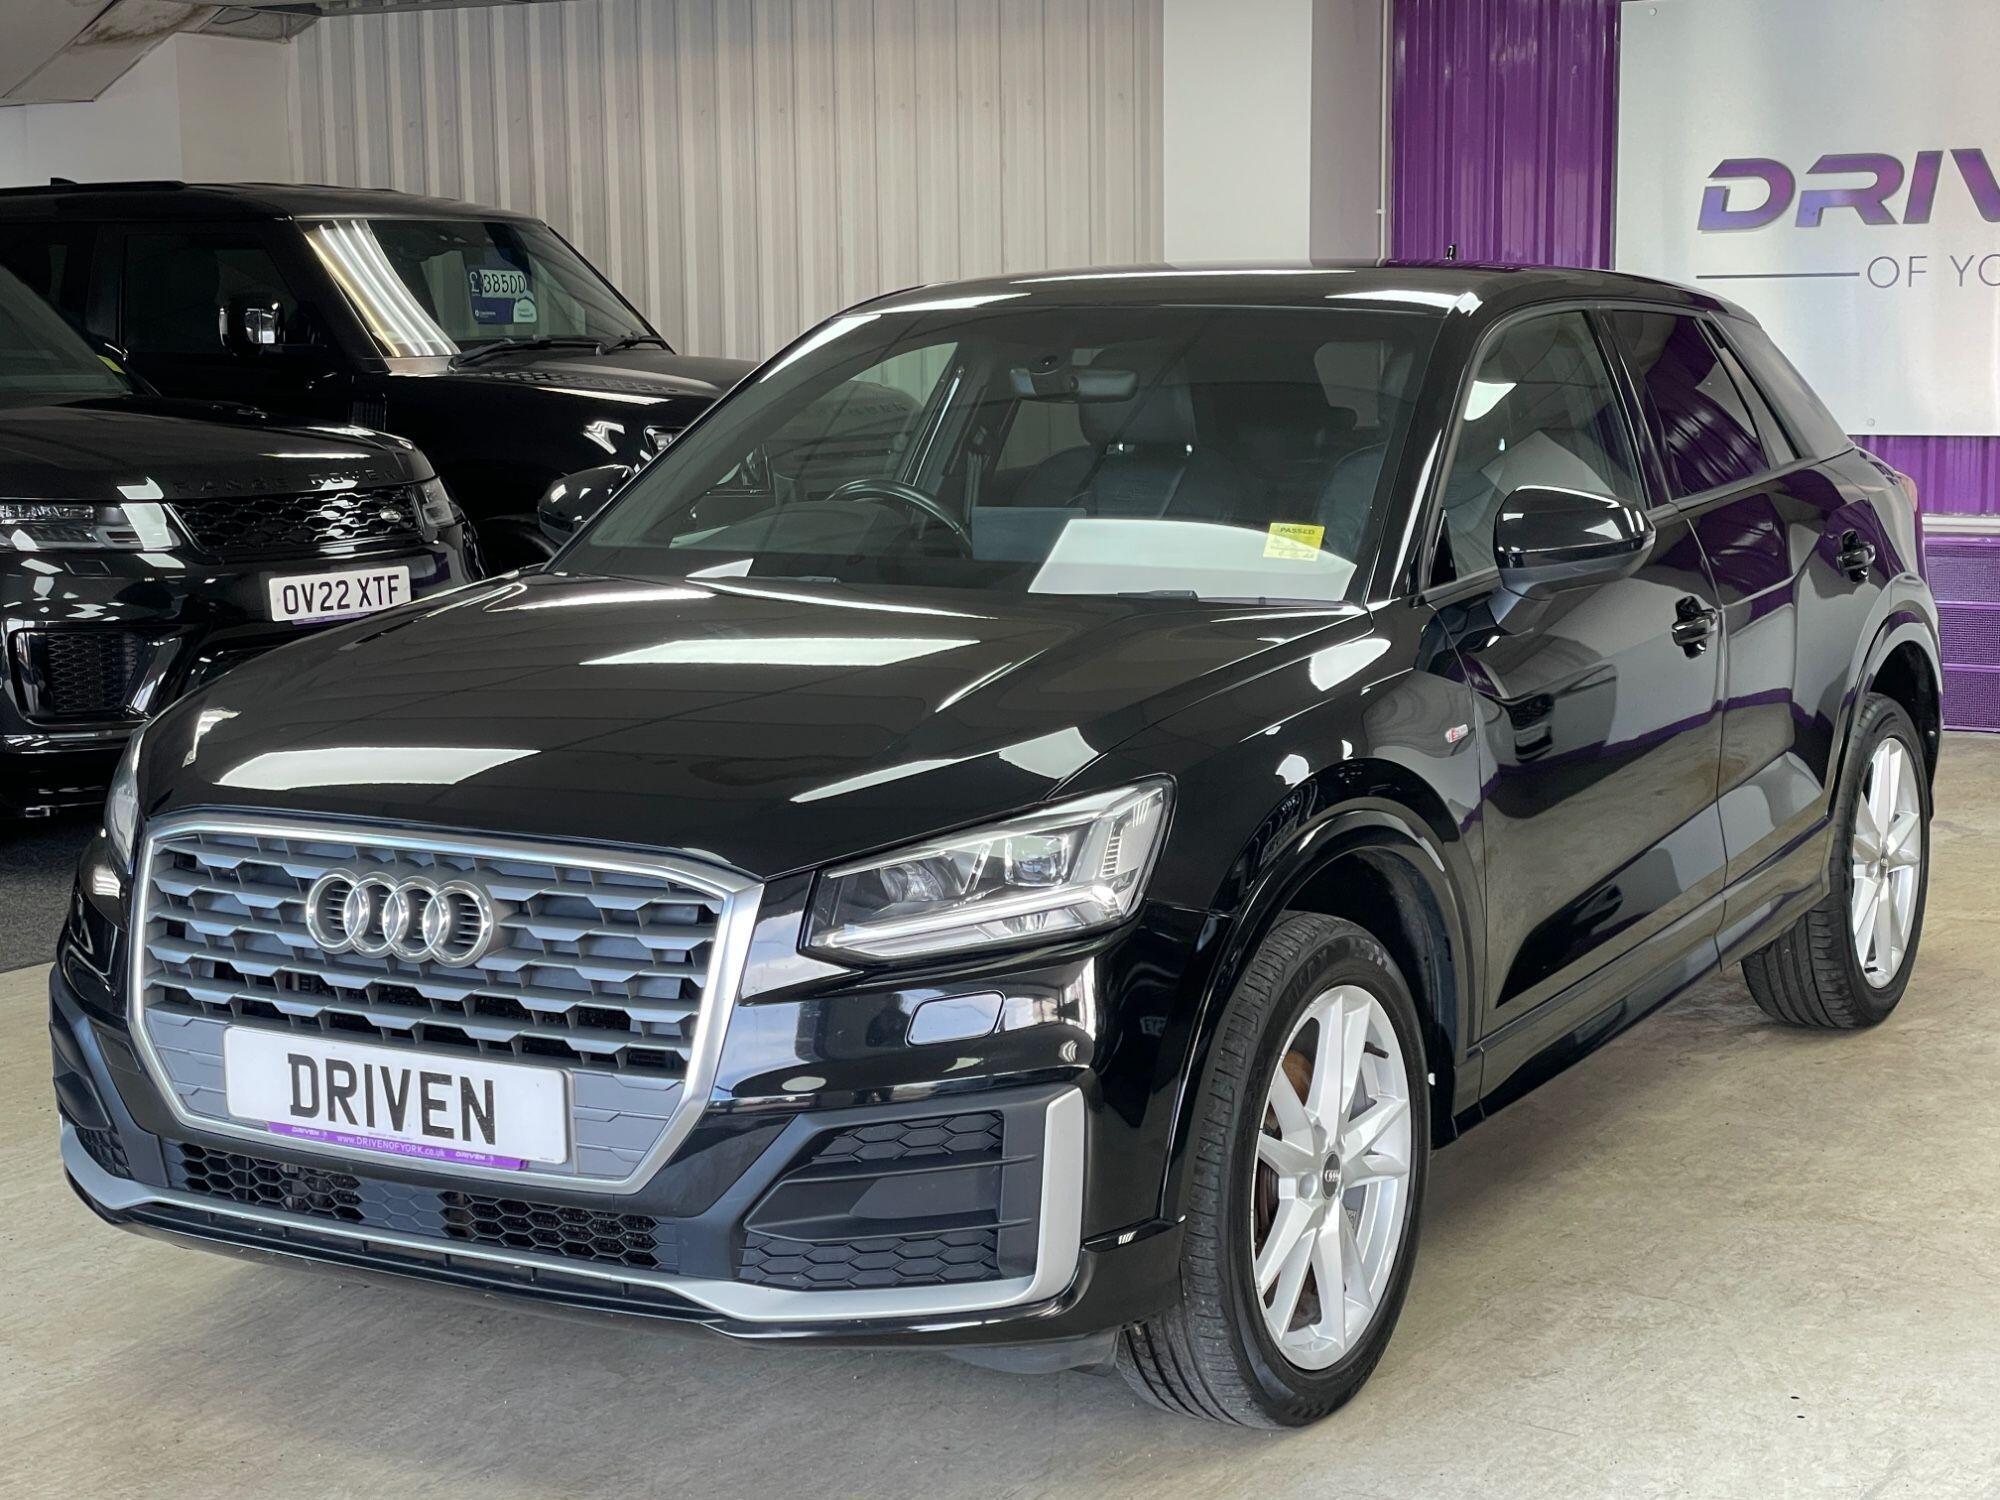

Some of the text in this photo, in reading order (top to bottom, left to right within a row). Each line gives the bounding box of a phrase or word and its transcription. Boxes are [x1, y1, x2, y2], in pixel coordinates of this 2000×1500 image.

[1867, 254, 2000, 288] OF YO
[282, 574, 400, 615] OV22 XTF
[287, 1053, 496, 1145] DRIVEN
[337, 1134, 446, 1159] www.DRIVENOFYORK.co.uk
